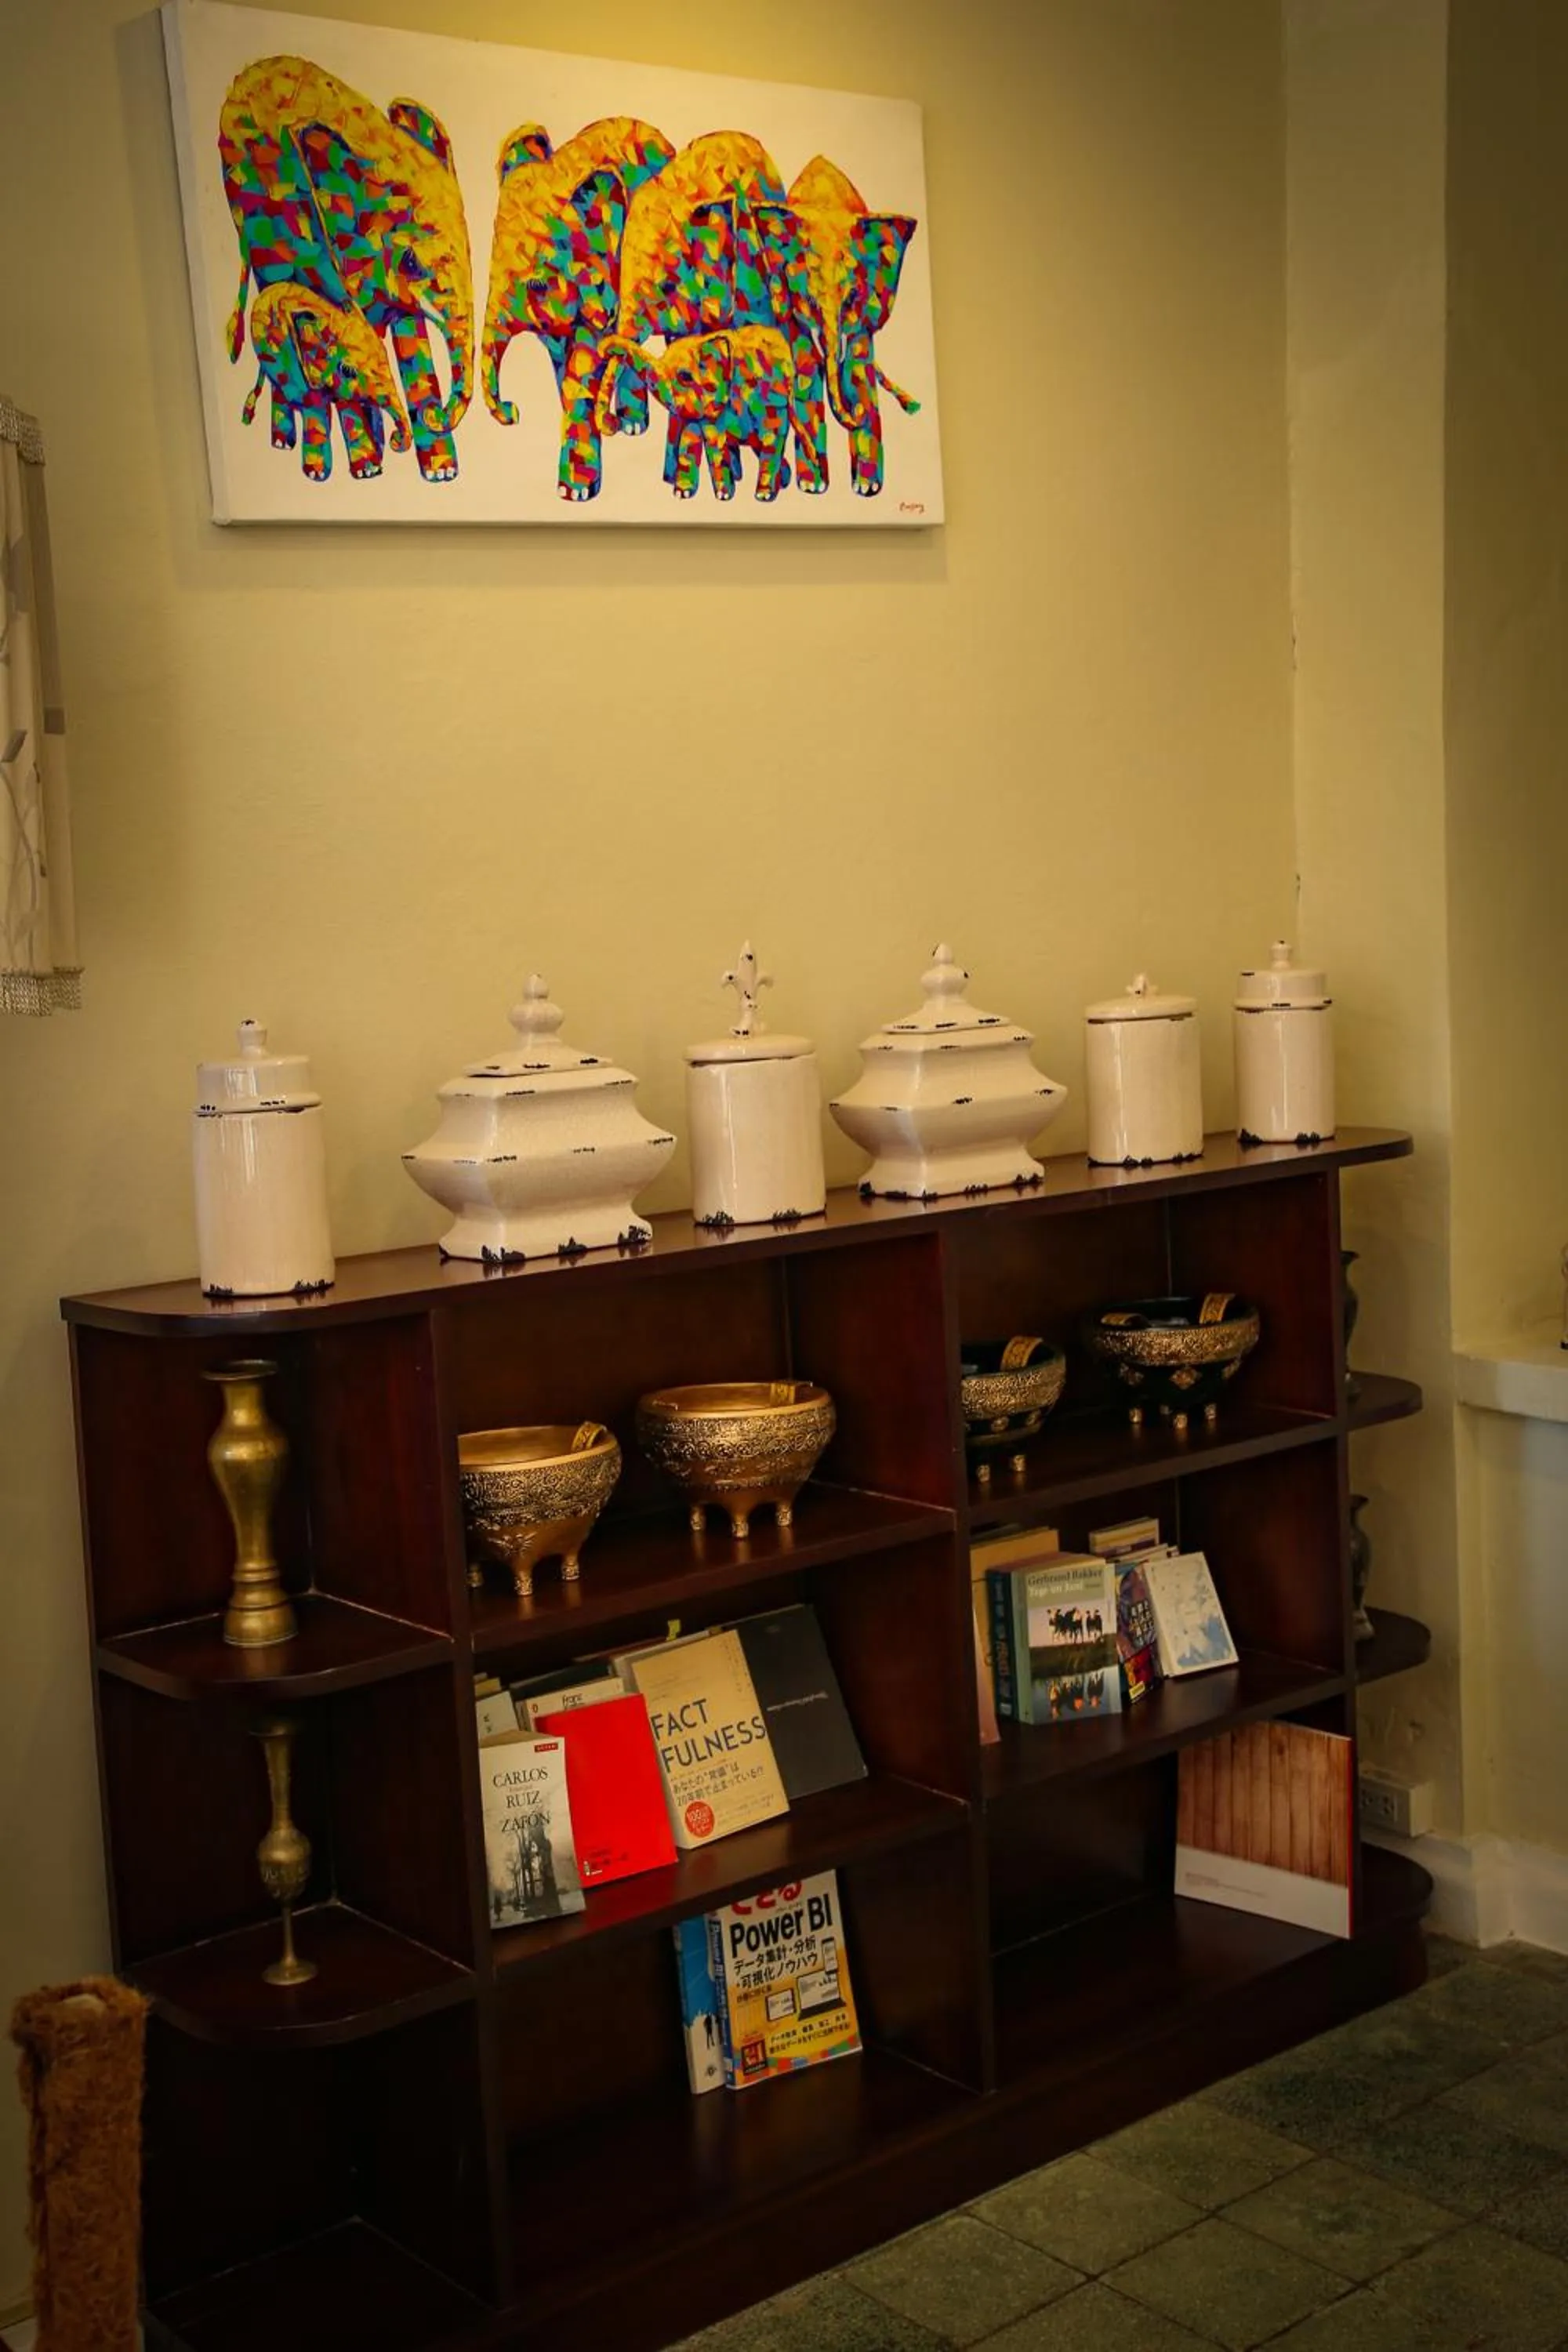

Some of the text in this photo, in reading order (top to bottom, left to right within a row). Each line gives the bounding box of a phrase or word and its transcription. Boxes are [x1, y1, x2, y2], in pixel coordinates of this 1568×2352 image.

[650, 1698, 707, 1741] FACT
[660, 1715, 767, 1773] FULNESS
[492, 1766, 549, 1788] CARLOS
[505, 1790, 543, 1809] RUIZ
[500, 1809, 550, 1833] ZAFÓN
[729, 1893, 833, 1959] Power BI
